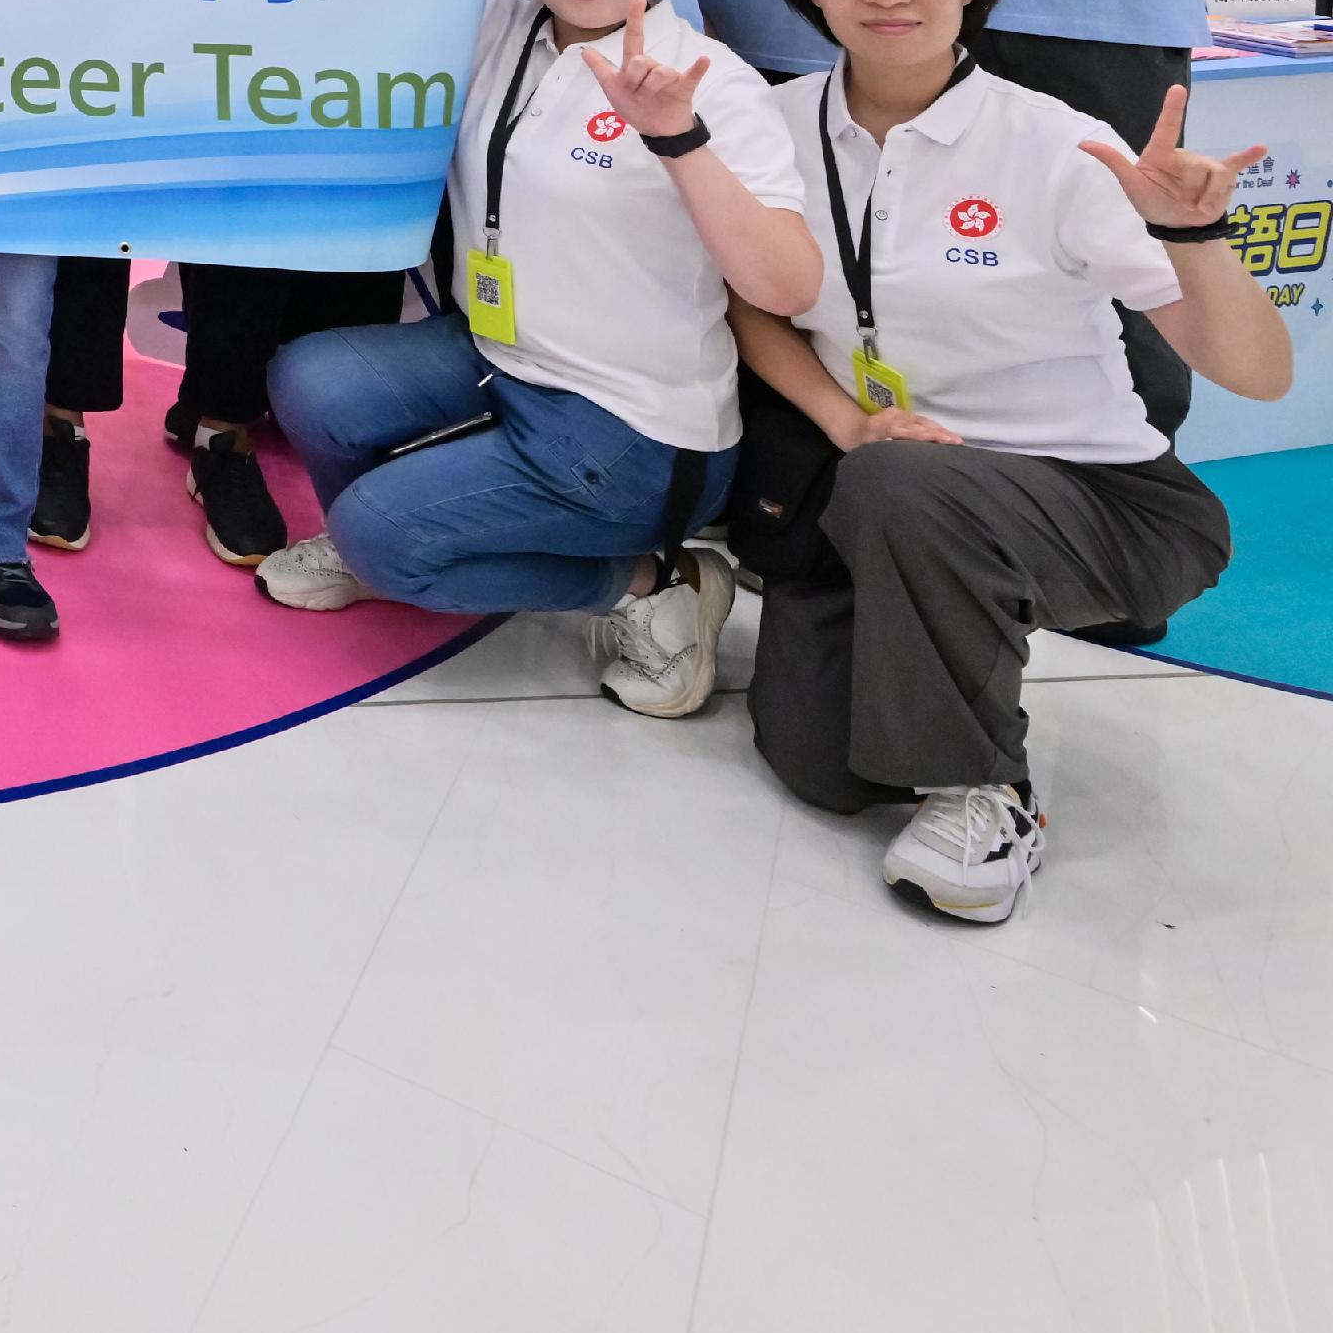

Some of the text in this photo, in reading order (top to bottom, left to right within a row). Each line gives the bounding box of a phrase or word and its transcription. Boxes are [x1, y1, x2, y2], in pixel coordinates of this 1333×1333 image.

[195, 43, 456, 130] Team
[570, 147, 613, 169] CSB
[945, 247, 999, 267] CSB
